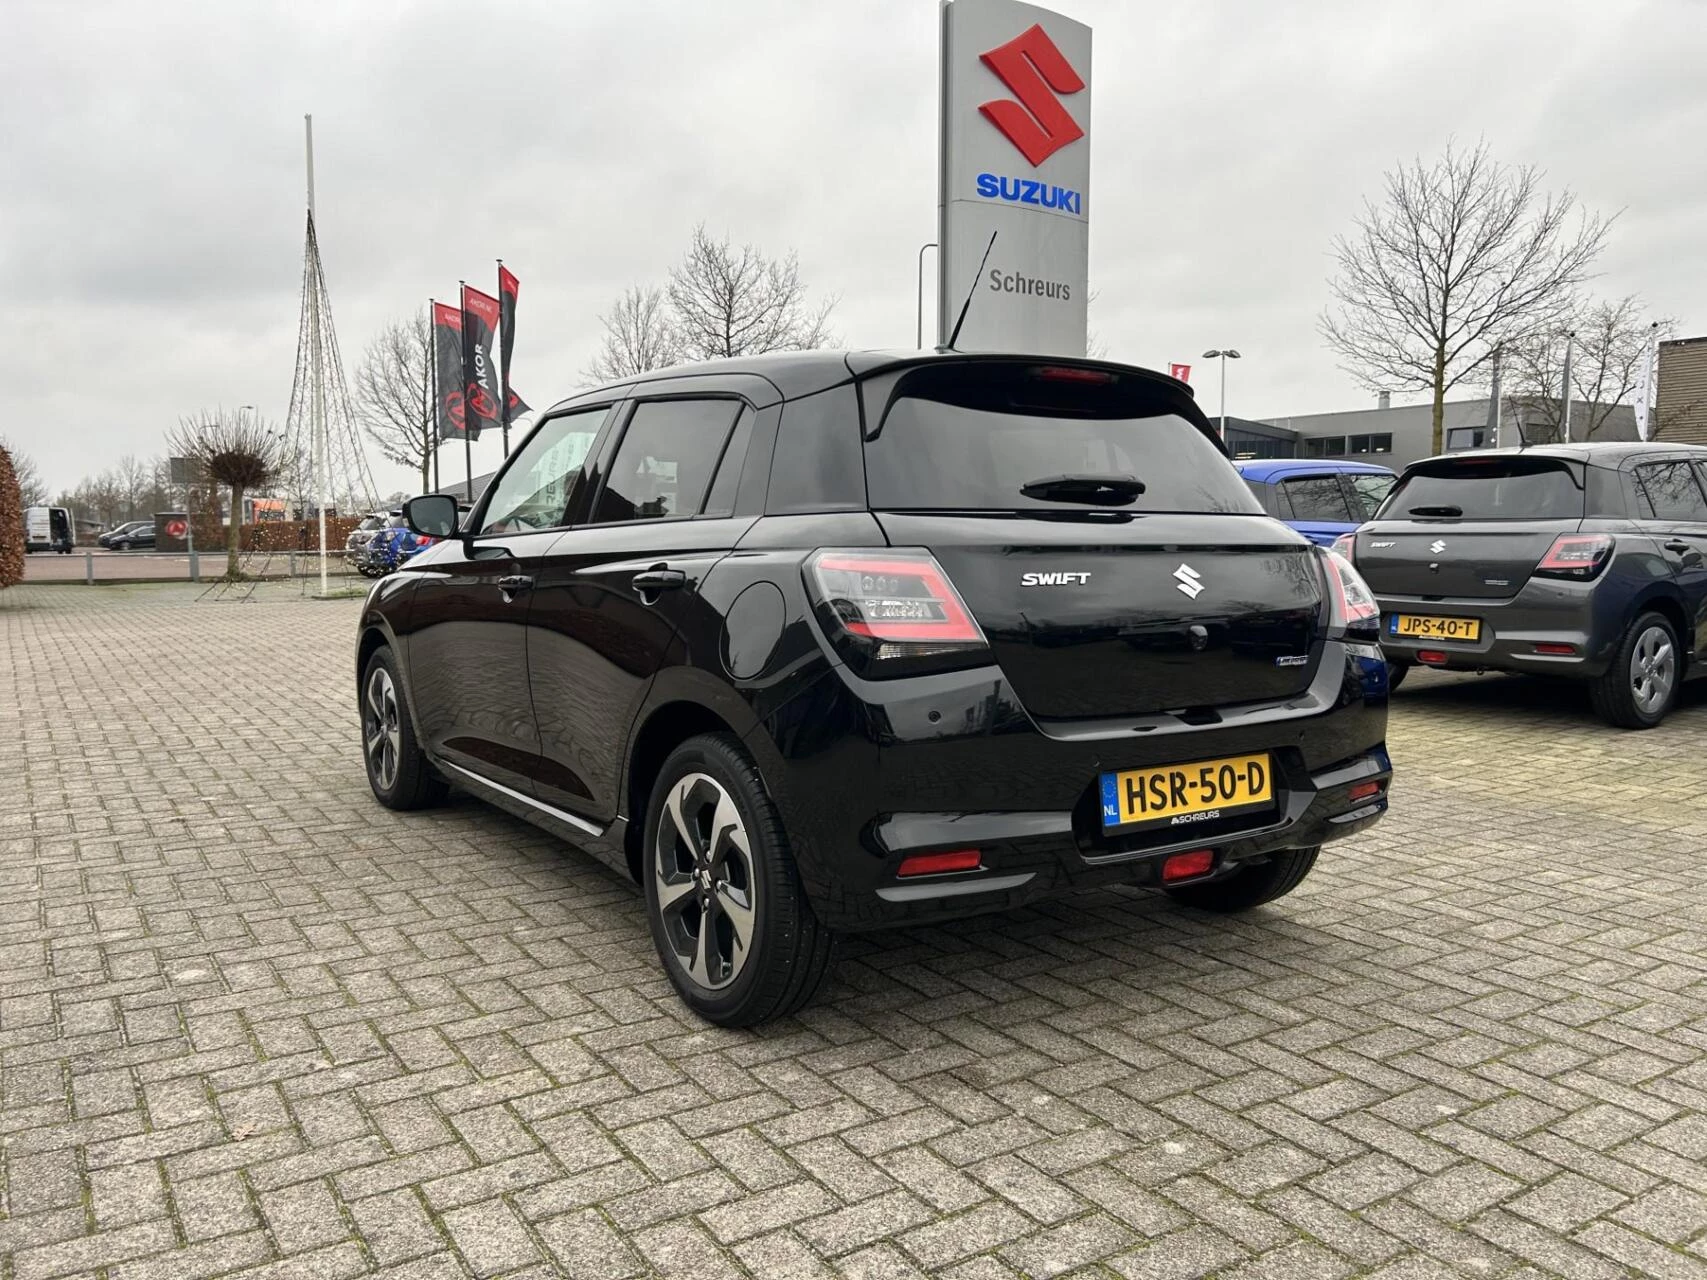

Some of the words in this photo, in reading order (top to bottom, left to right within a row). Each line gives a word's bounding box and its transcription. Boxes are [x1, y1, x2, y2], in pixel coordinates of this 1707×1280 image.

[976, 173, 1081, 215] SUZUKI
[989, 268, 1071, 301] Schreurs
[474, 343, 489, 390] AKOR
[1021, 572, 1092, 586] SWIFT
[1403, 617, 1474, 636] JPS-40-T
[1125, 761, 1265, 815] HSR-50-D
[1103, 803, 1118, 817] NL
[1178, 809, 1220, 824] SCHREURS
